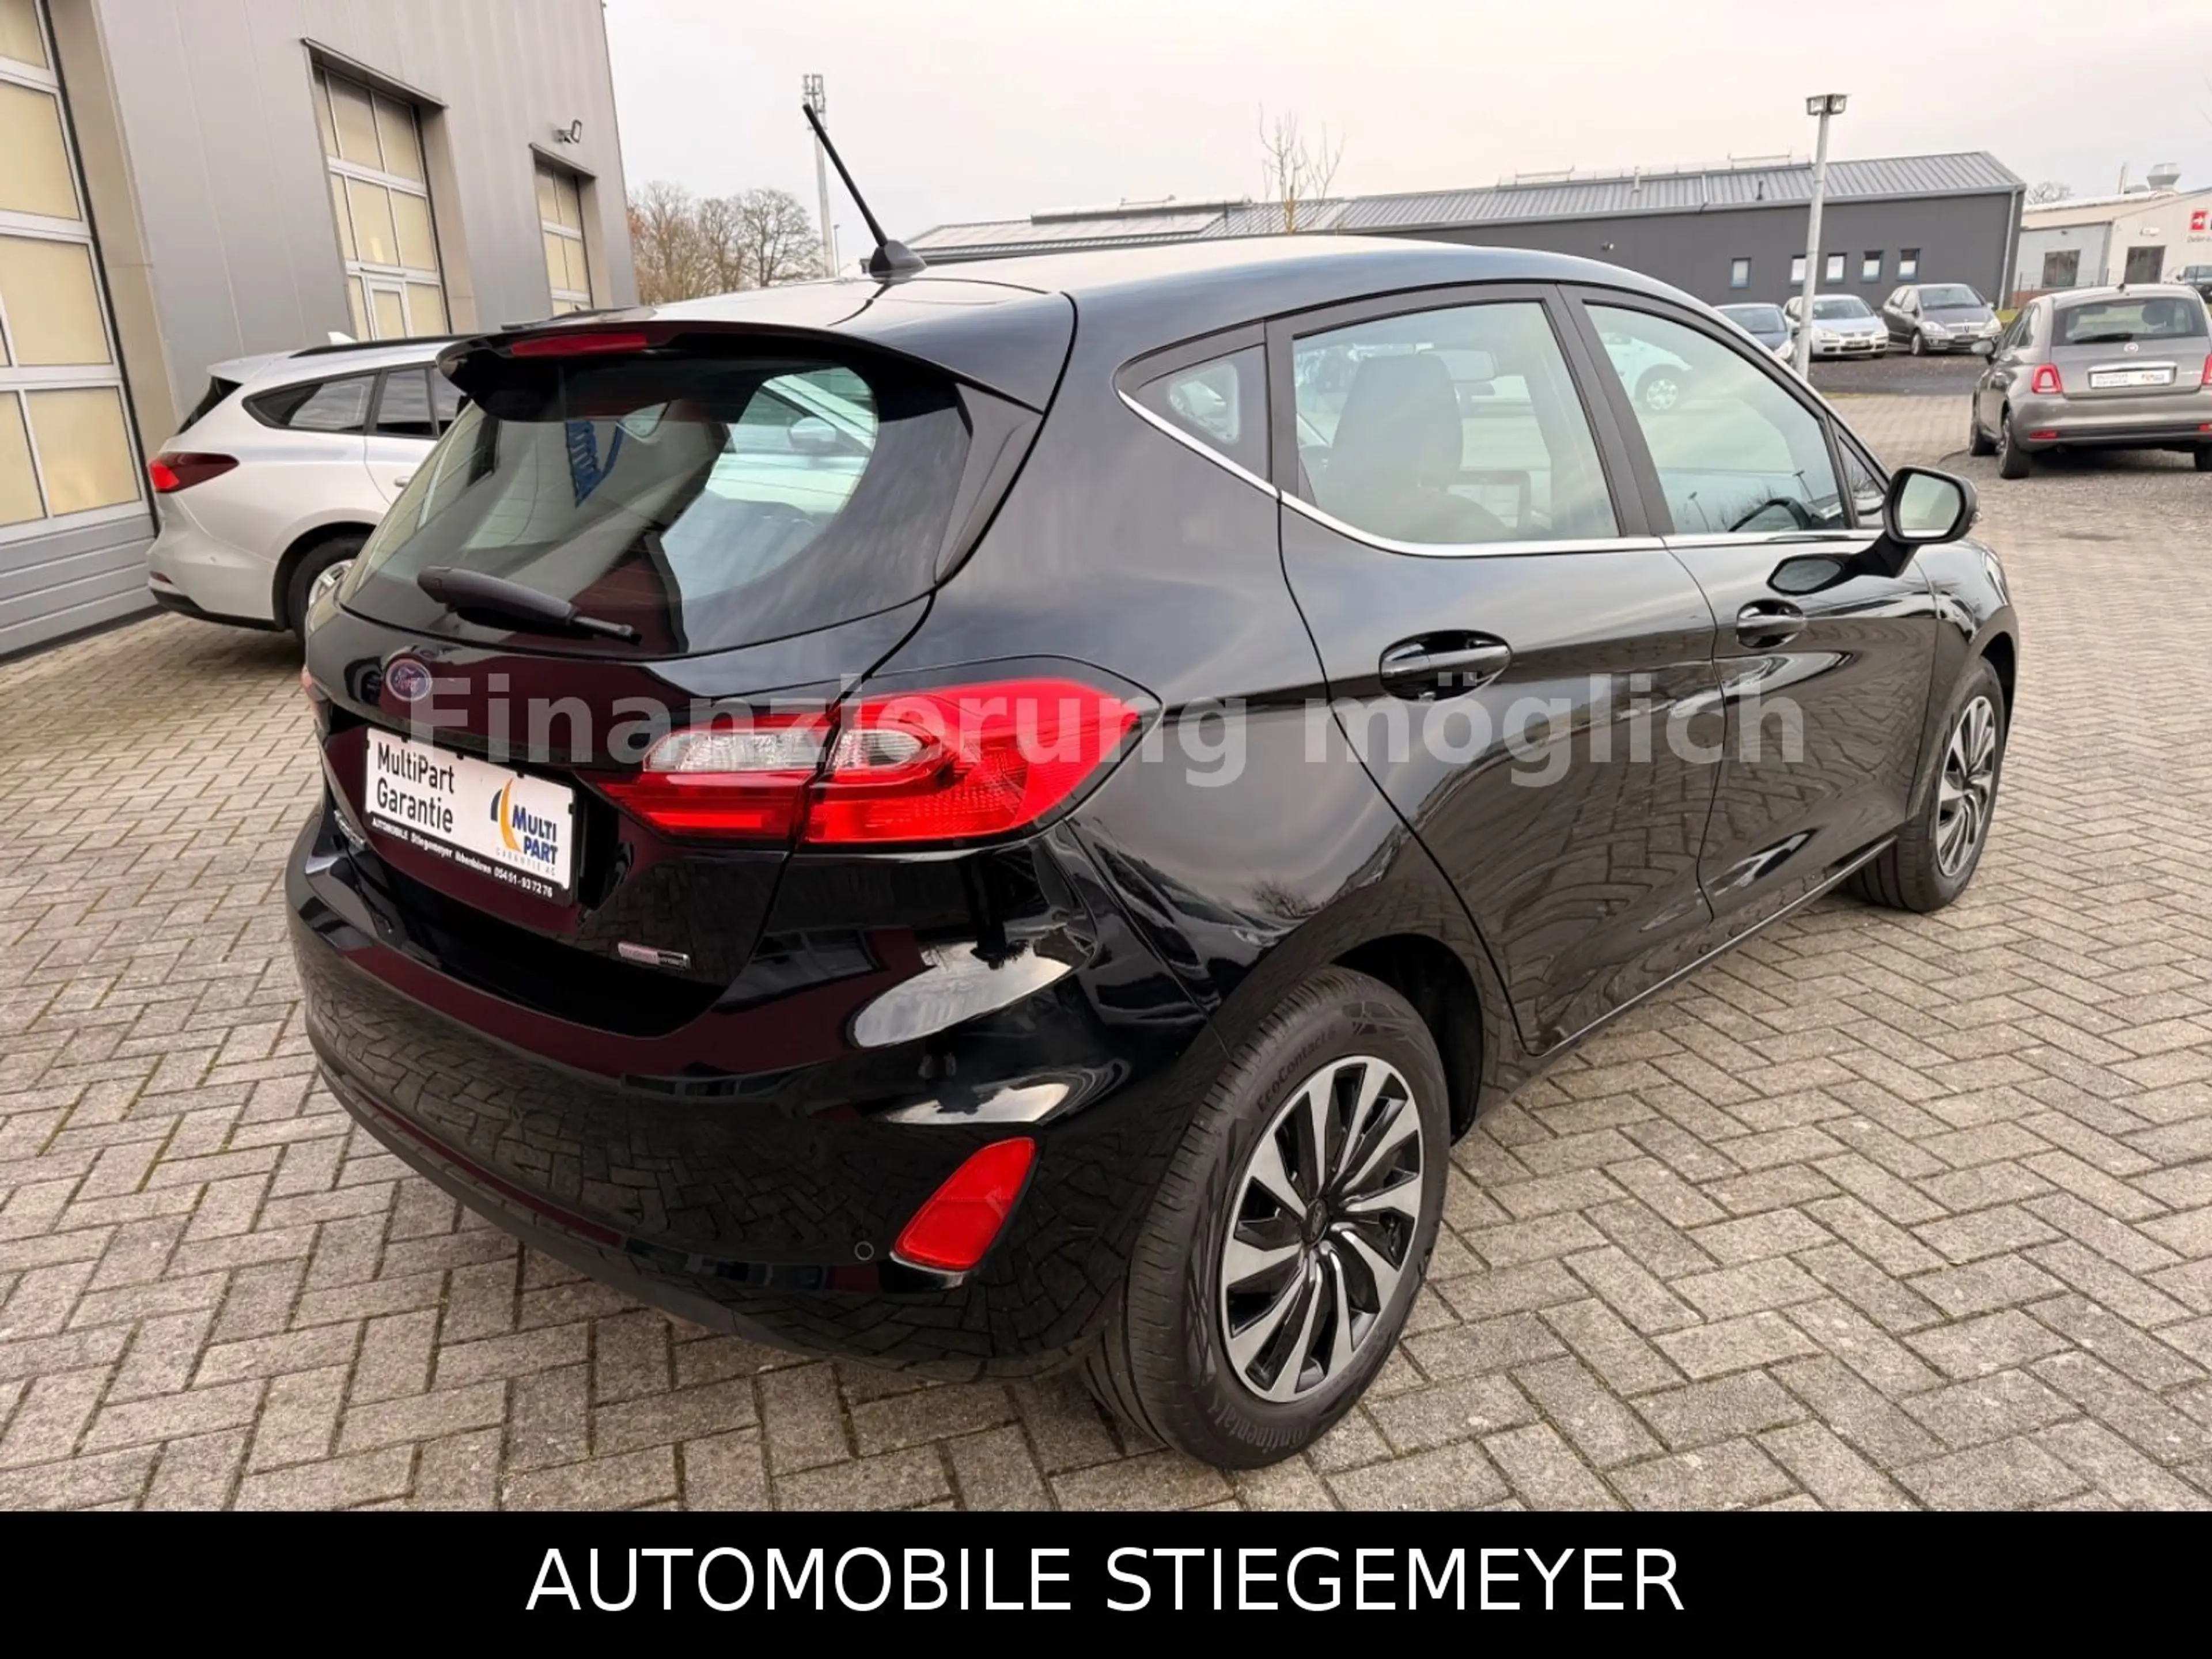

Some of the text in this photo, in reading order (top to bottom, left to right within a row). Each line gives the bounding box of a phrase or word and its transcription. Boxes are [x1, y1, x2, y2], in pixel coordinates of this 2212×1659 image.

[377, 742, 454, 794] MultiPart
[377, 777, 453, 834] Garantie
[512, 804, 557, 843] MULTI
[523, 835, 559, 866] PART
